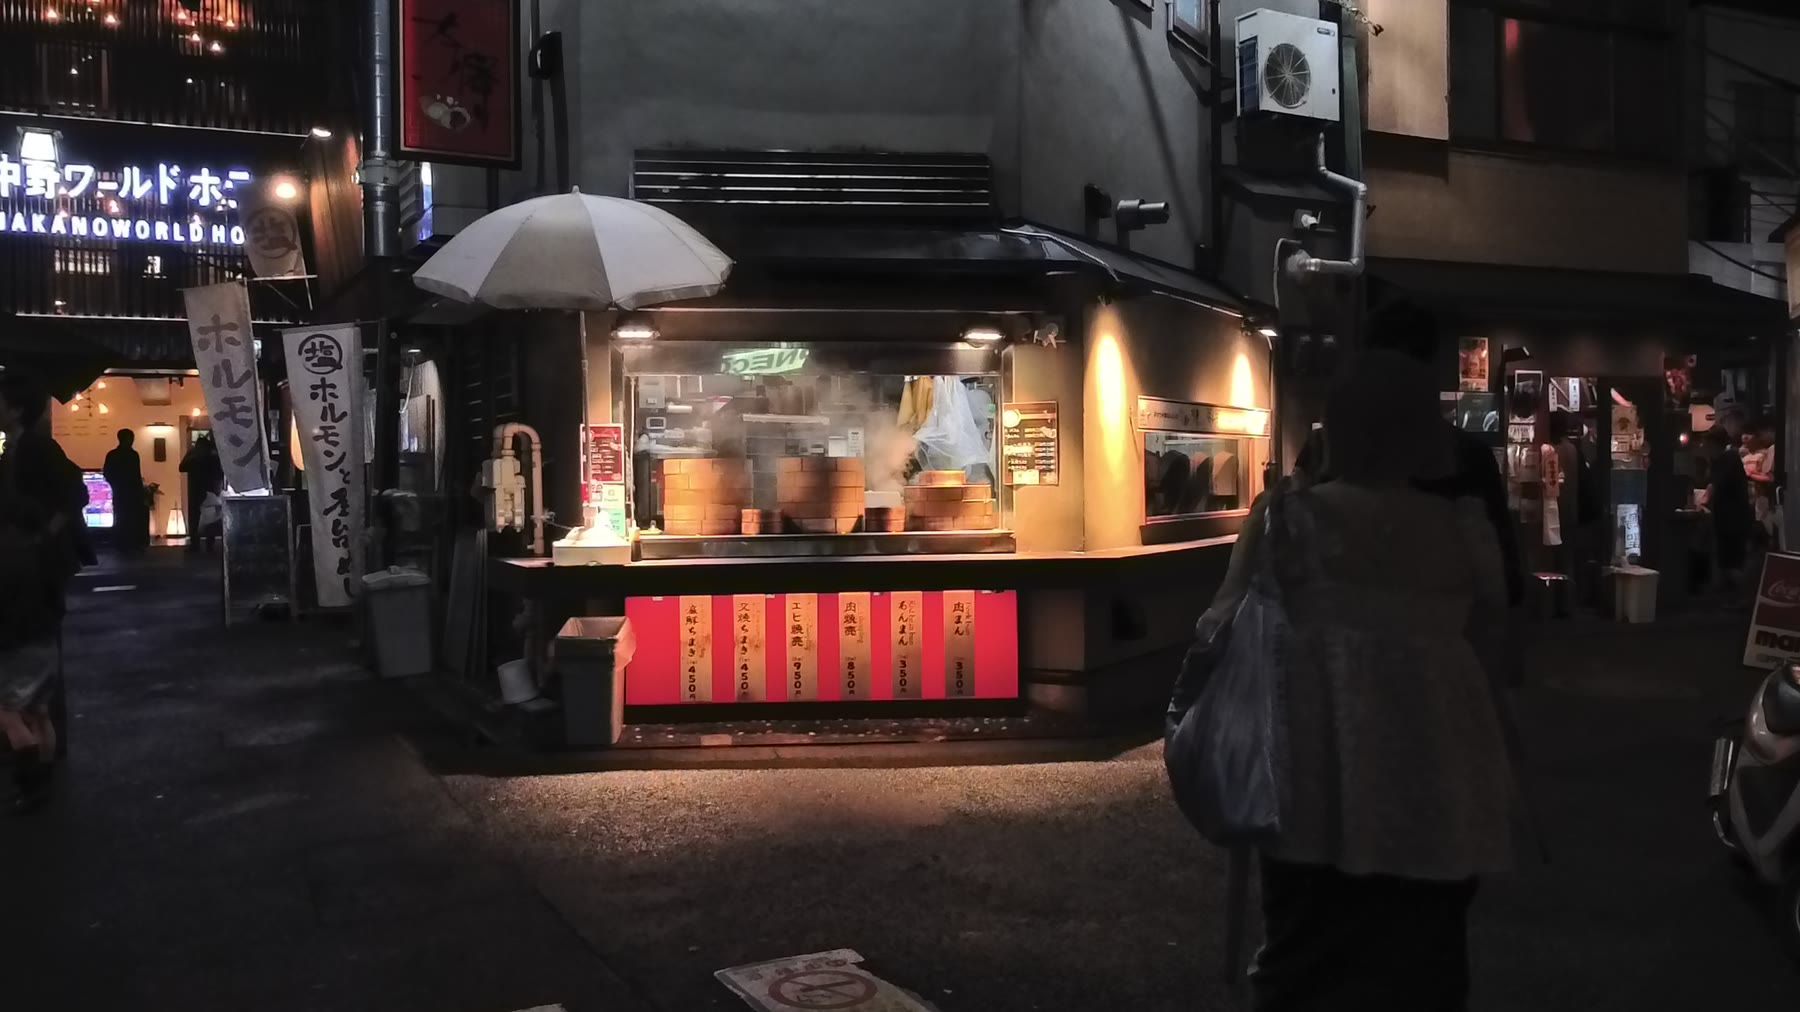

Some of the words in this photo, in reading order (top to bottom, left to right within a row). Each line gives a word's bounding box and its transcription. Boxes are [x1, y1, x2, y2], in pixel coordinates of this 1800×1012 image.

[197, 313, 261, 467] ホルモン
[898, 600, 908, 646] あんまん
[952, 601, 964, 636] 肉まん
